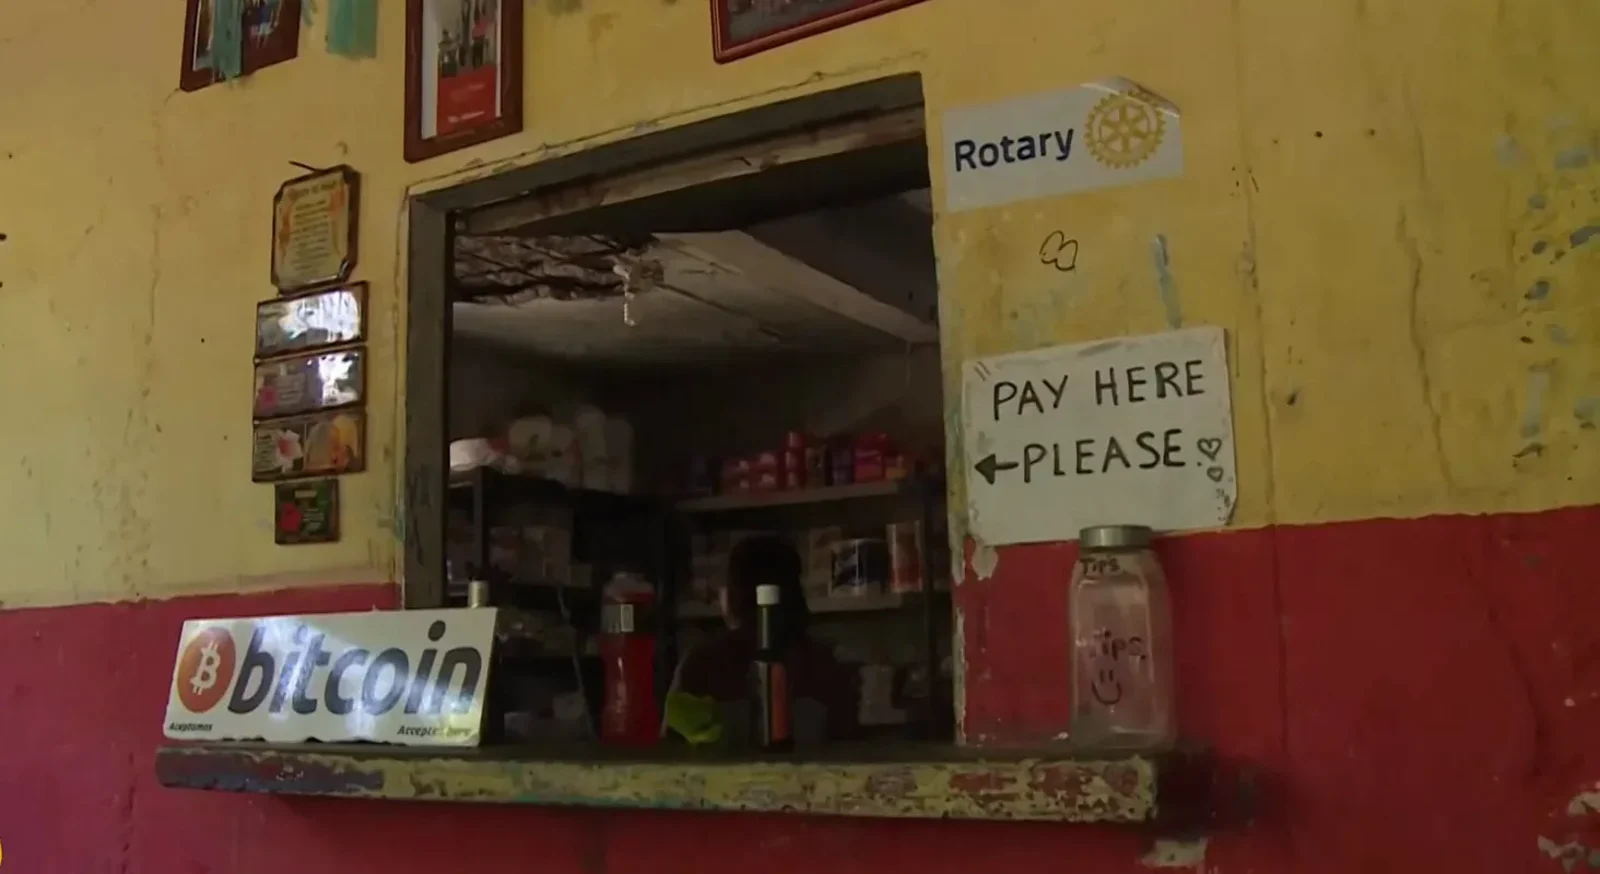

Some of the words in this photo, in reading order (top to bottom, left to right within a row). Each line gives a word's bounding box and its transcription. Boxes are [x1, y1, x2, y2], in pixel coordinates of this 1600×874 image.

[953, 128, 1075, 172] Rotary
[993, 374, 1068, 421] PAY
[1095, 359, 1206, 407] HERE
[227, 620, 482, 716] bitcoin
